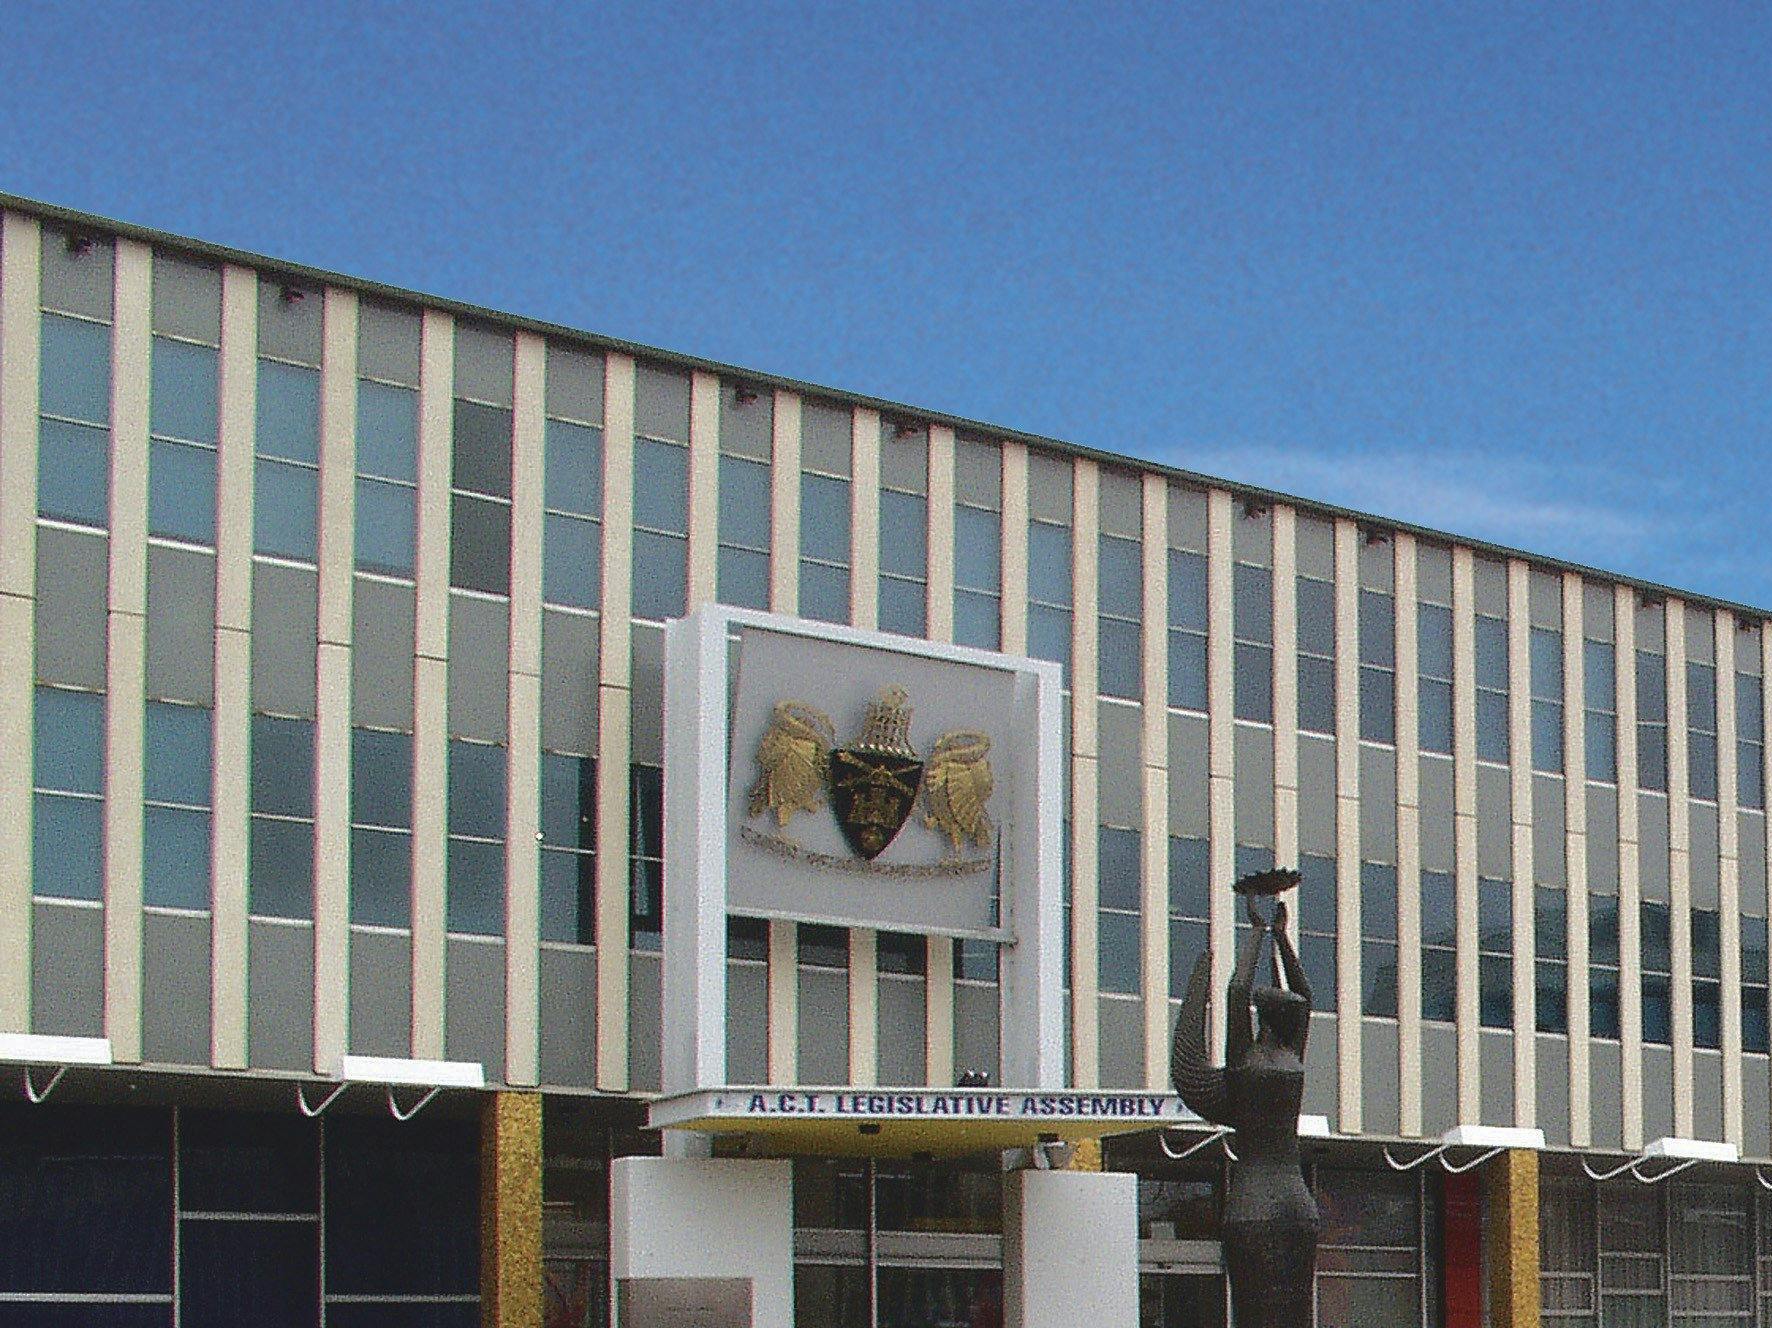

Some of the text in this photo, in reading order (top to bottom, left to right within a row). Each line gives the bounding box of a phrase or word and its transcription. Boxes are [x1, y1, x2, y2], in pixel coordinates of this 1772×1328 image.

[749, 1094, 1165, 1116] A.C.T. LEGISLATIVE ASSEMBLY
